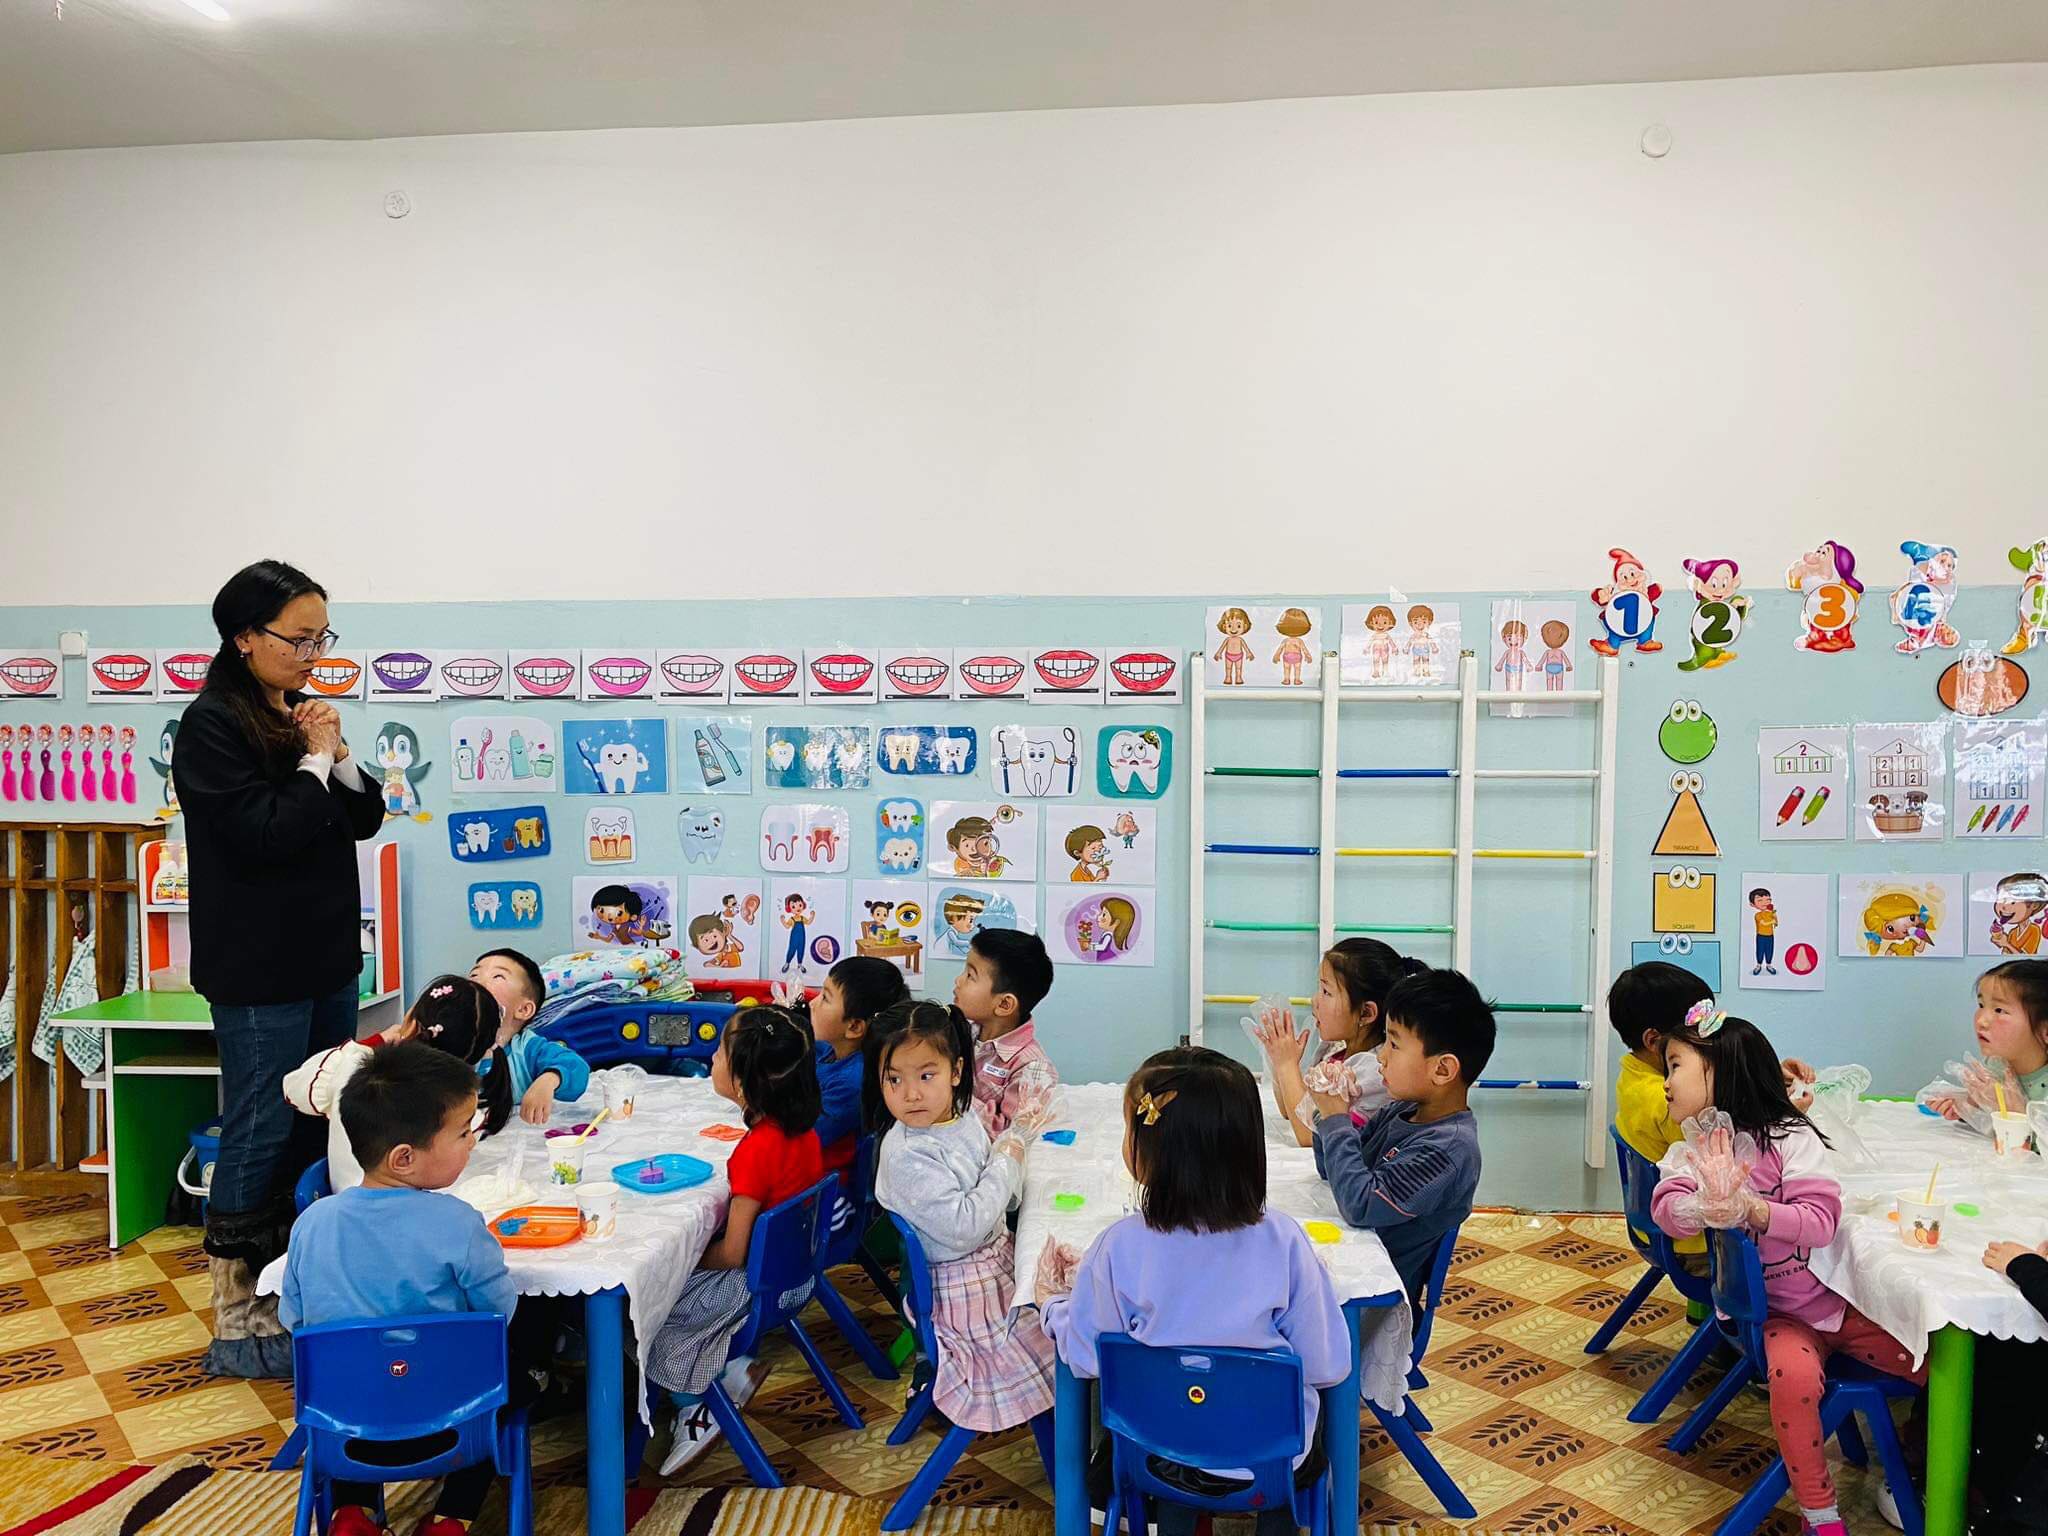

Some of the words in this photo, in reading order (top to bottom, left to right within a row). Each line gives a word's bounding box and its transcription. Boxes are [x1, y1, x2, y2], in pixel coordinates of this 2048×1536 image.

[1812, 585, 1846, 628] 3
[1613, 592, 1640, 635] 1
[1699, 602, 1734, 645] 2
[1799, 744, 1807, 756] 2
[1895, 742, 1903, 754] 3
[1787, 760, 1792, 770] 1
[1814, 760, 1819, 770] 1
[1881, 759, 1888, 769] 2
[1910, 758, 1915, 769] 1
[1882, 774, 1887, 784] 1
[1910, 774, 1916, 784] 2
[1982, 787, 1987, 797] 1
[2010, 786, 2017, 797] 3
